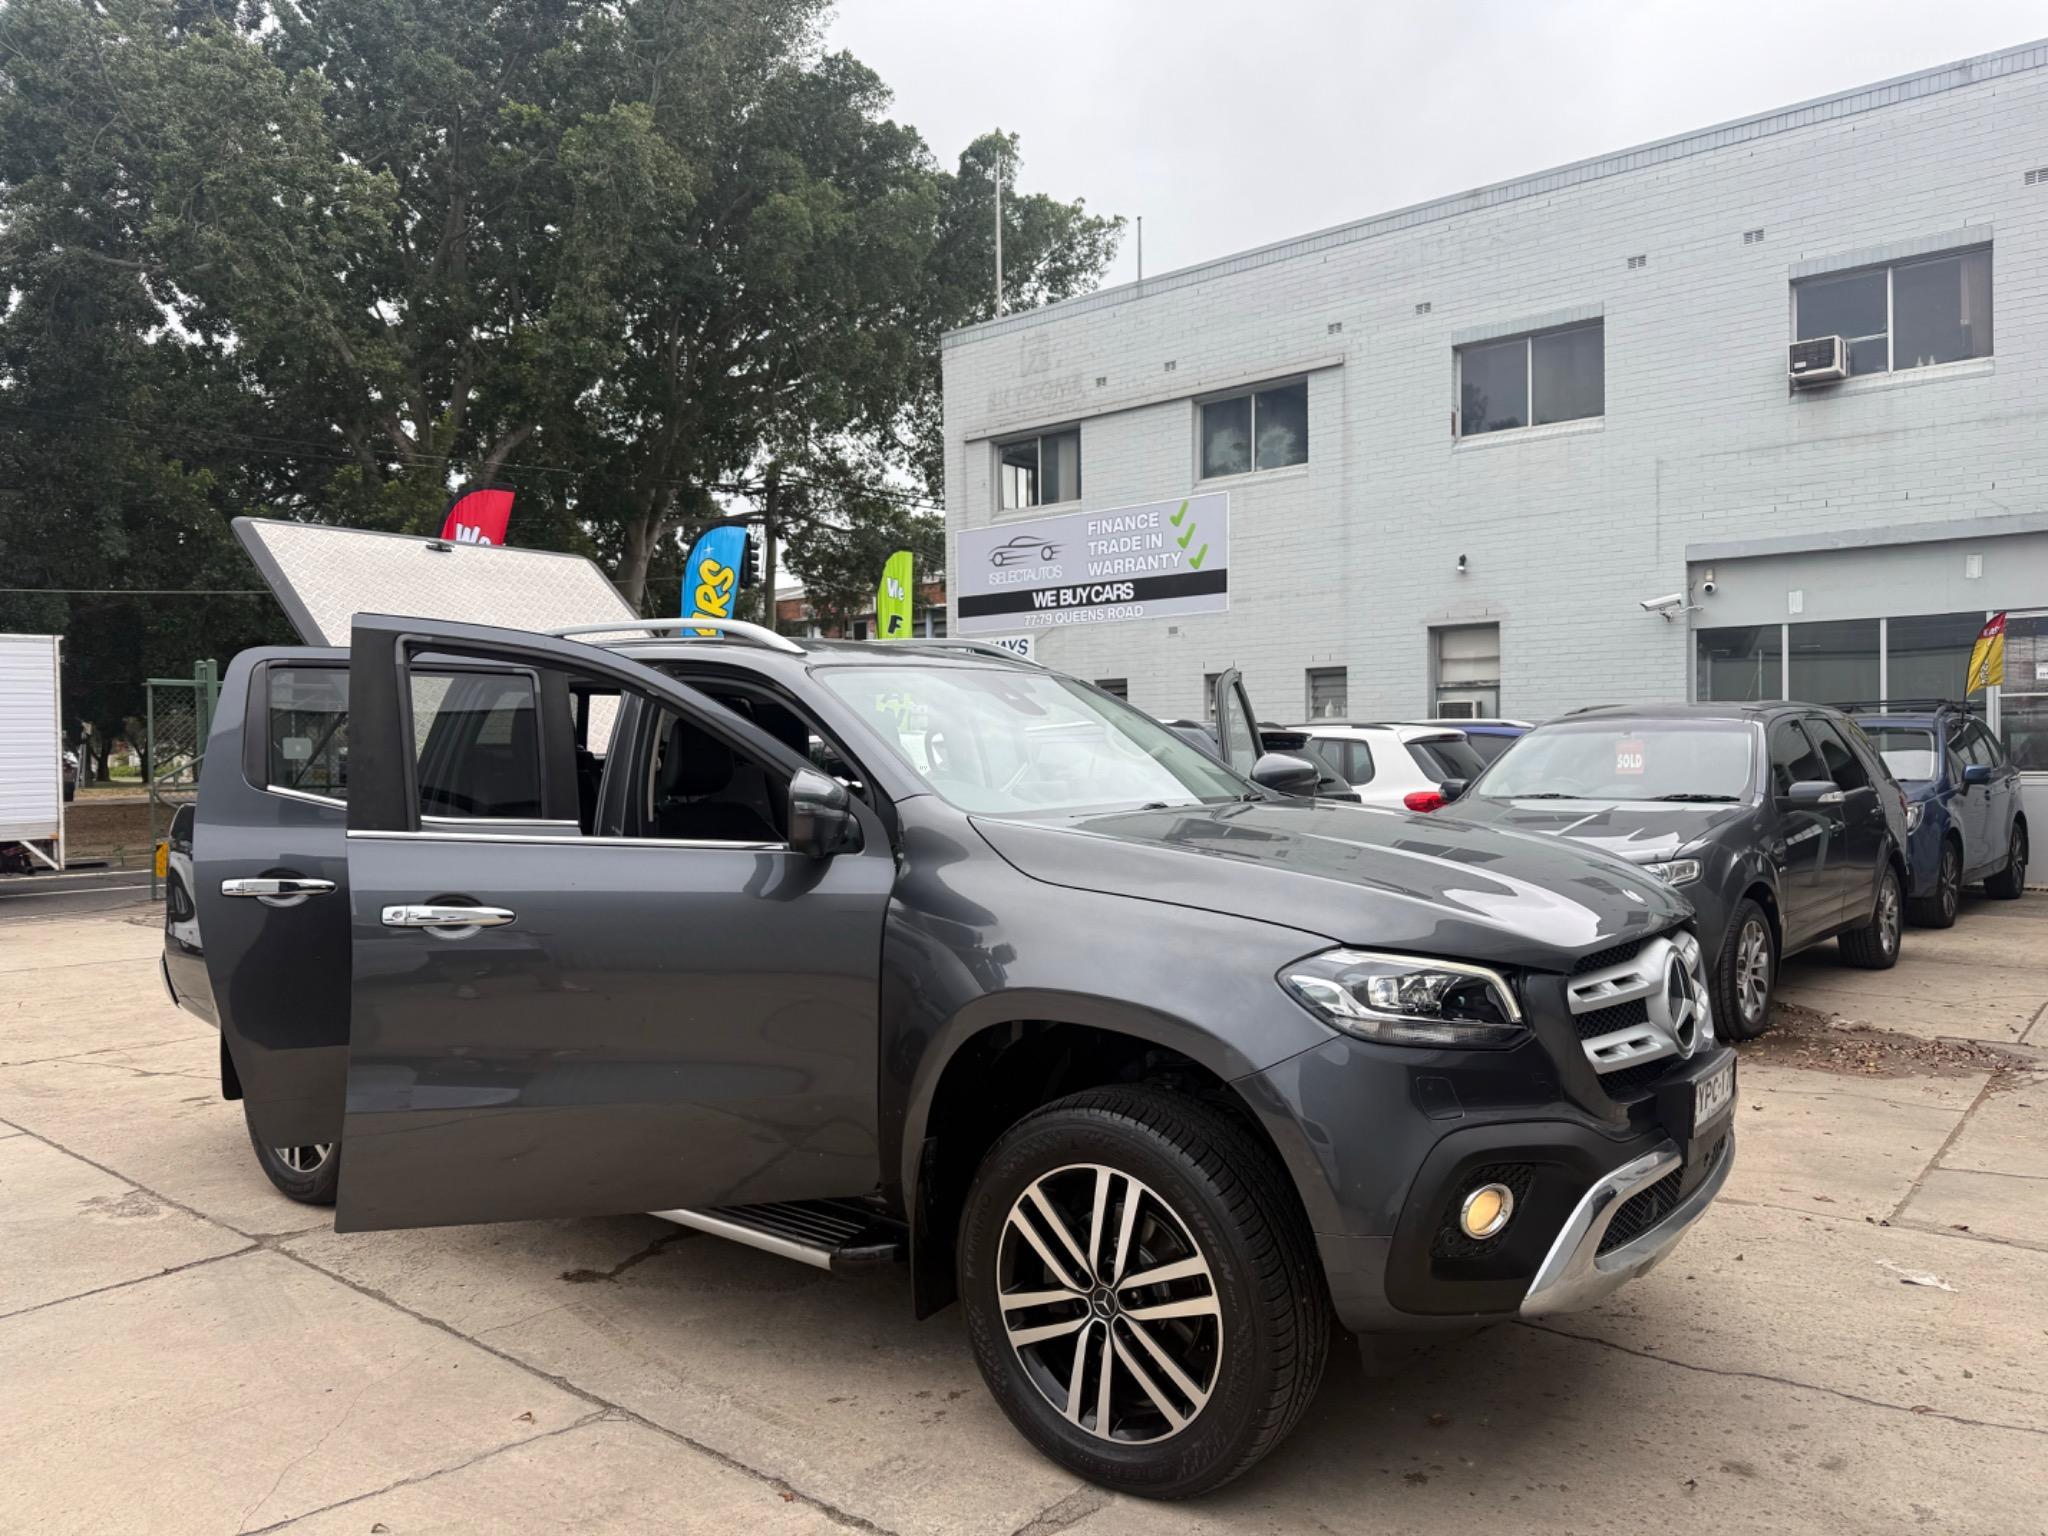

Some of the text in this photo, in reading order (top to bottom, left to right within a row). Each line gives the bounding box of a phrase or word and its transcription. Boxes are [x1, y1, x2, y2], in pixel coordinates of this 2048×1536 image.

[1087, 512, 1159, 536] FINANCE
[1087, 532, 1163, 556] TRADE IN
[1087, 551, 1182, 577] WARRANTY
[1032, 582, 1135, 608] WE BUY CARS
[1055, 608, 1105, 624] QUEENS
[1107, 605, 1144, 620] ROAD
[1617, 753, 1643, 768] SOLD
